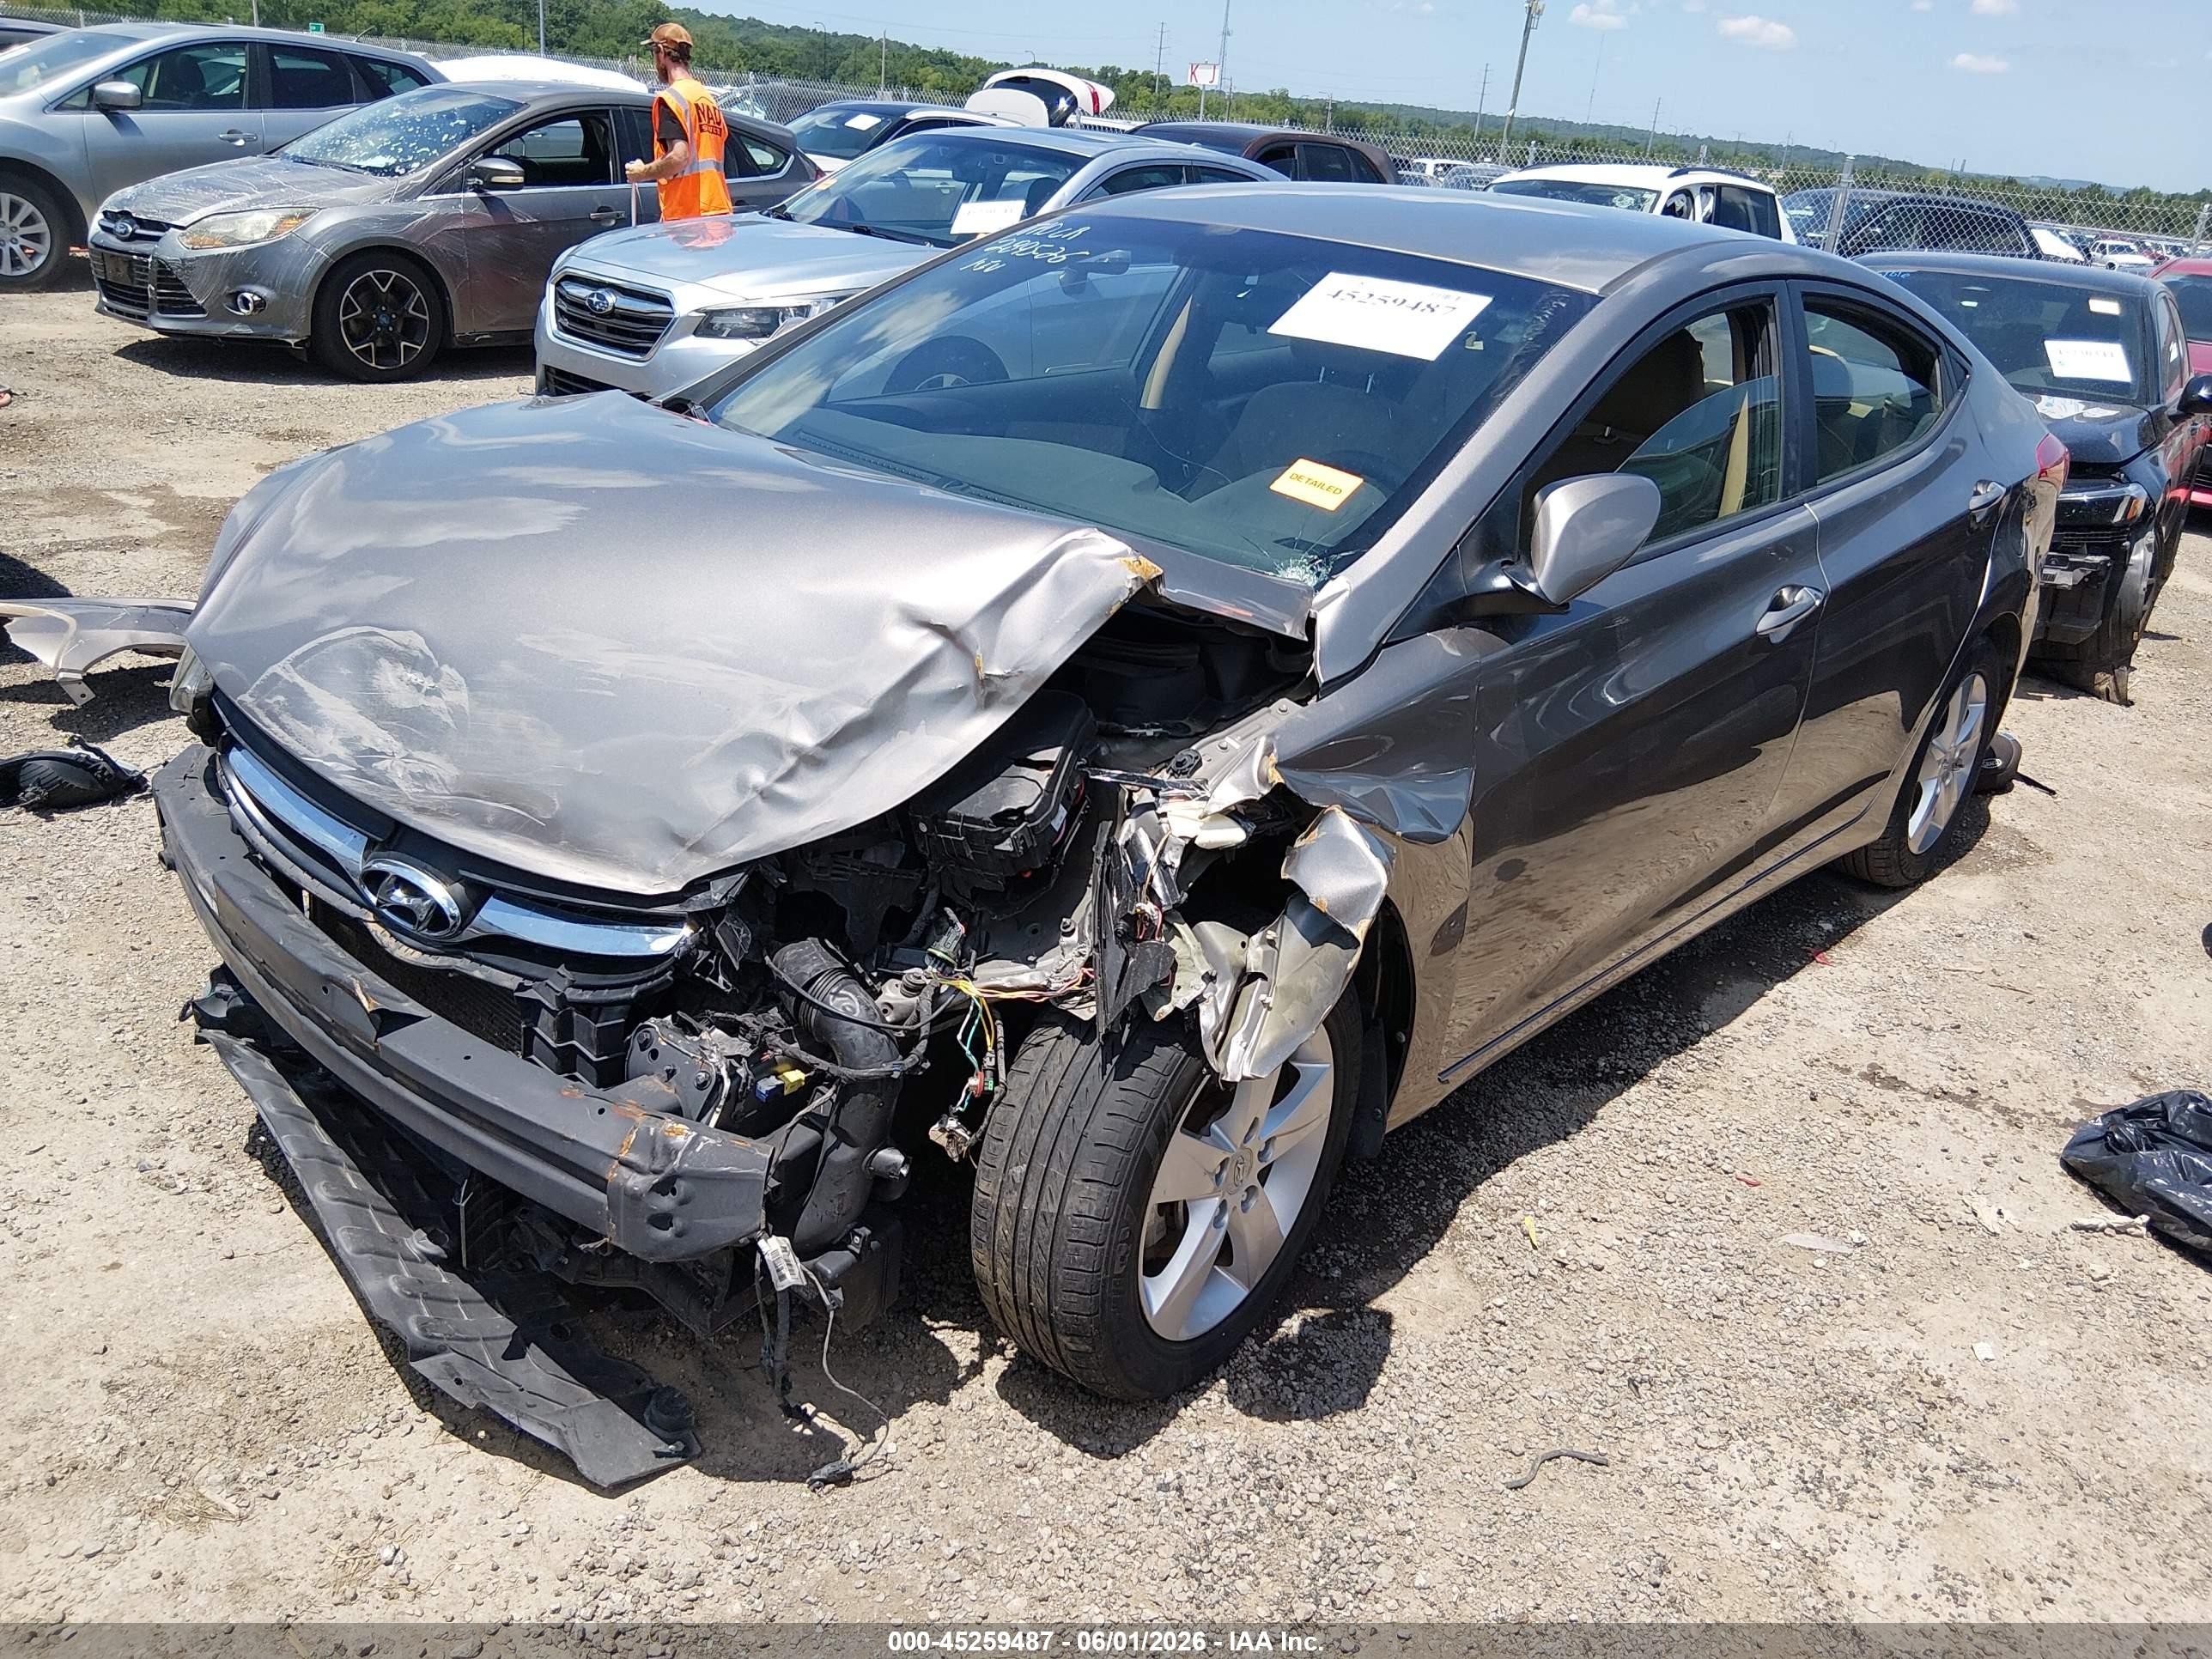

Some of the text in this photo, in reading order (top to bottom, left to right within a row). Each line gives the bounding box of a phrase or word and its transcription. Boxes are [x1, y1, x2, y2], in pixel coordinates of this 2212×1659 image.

[1190, 64, 1217, 84] K J
[1326, 289, 1457, 316] 45259487
[1289, 472, 1343, 495] DETAILED
